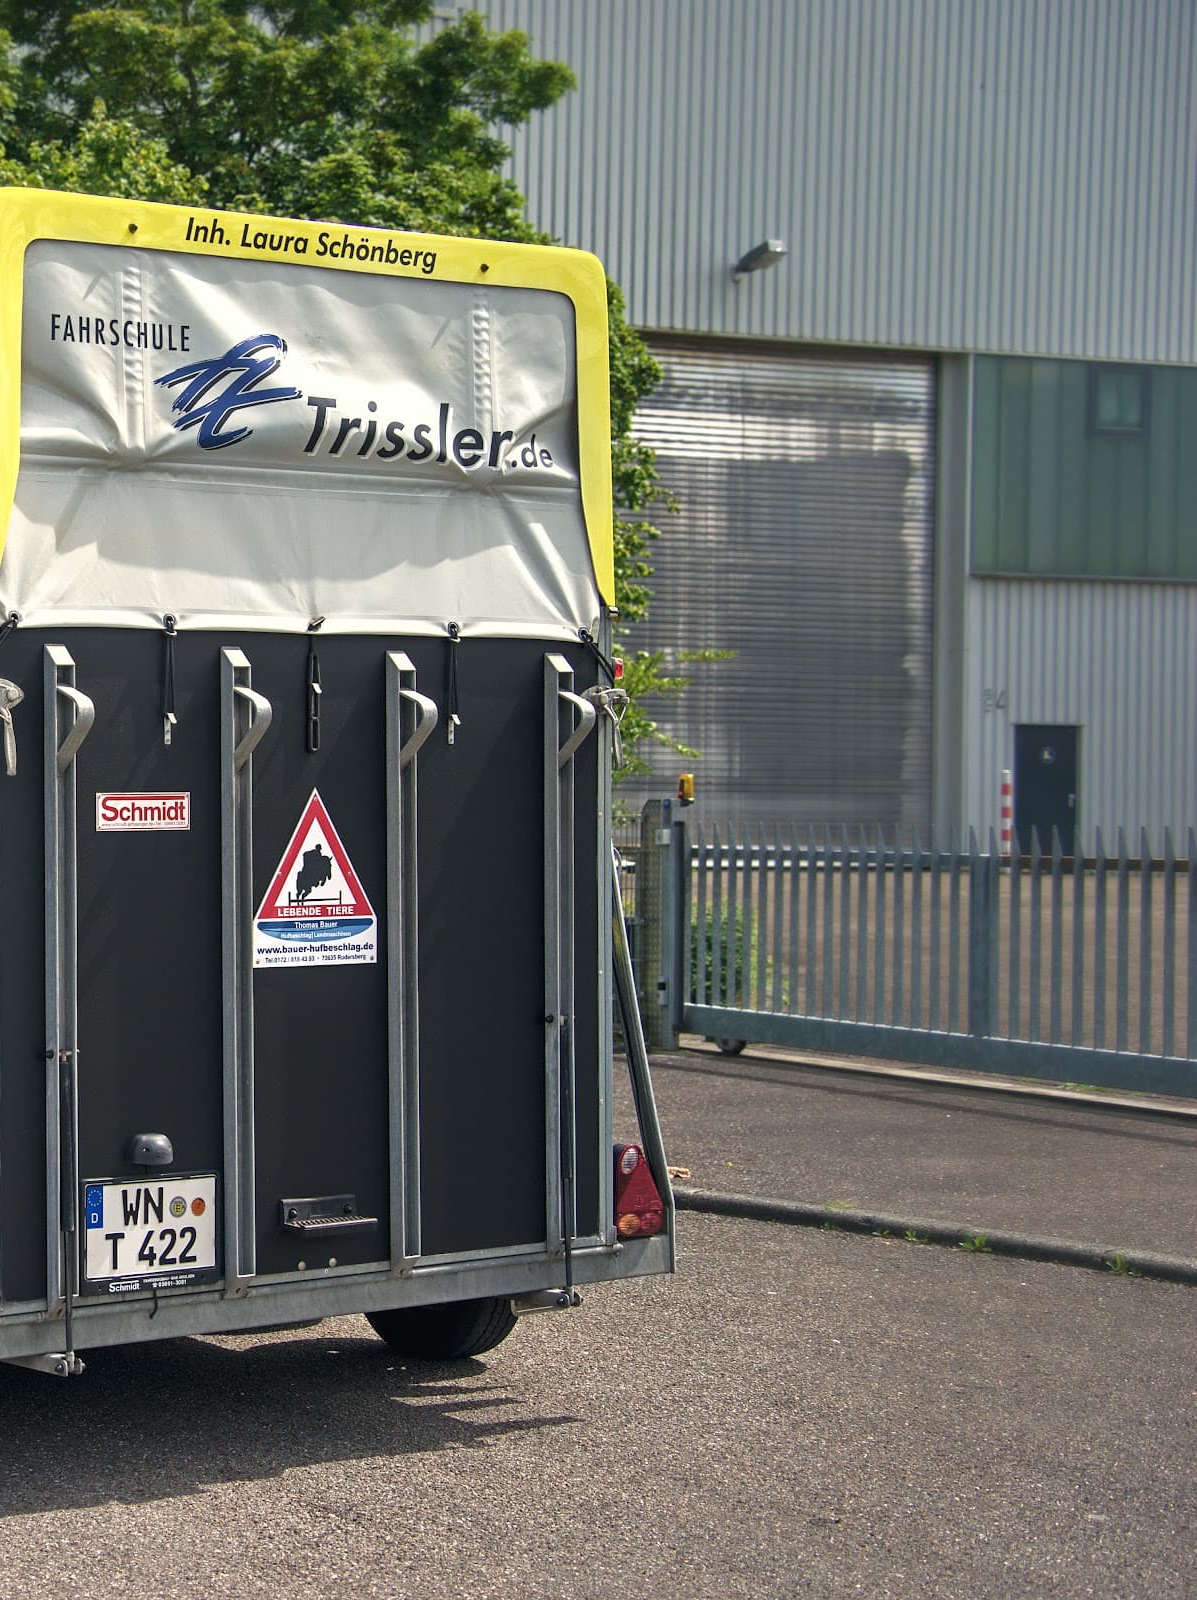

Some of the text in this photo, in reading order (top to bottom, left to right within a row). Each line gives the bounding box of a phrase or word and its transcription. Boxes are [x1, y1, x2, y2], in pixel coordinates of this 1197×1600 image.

[185, 217, 437, 274] Inh. Laura Schönberg
[49, 313, 191, 353] FAHRSCHULE
[303, 396, 553, 472] Trissler.de
[101, 795, 186, 822] Schmidt
[277, 905, 355, 917] LEBENDE TIERE
[294, 920, 338, 929] Thomas Bauer
[257, 941, 374, 955] www.bauer-hufbeschlag.de
[91, 1212, 99, 1224] D
[121, 1186, 164, 1227] WN
[105, 1226, 197, 1271] T 422
[108, 1279, 140, 1293] Schmidt
